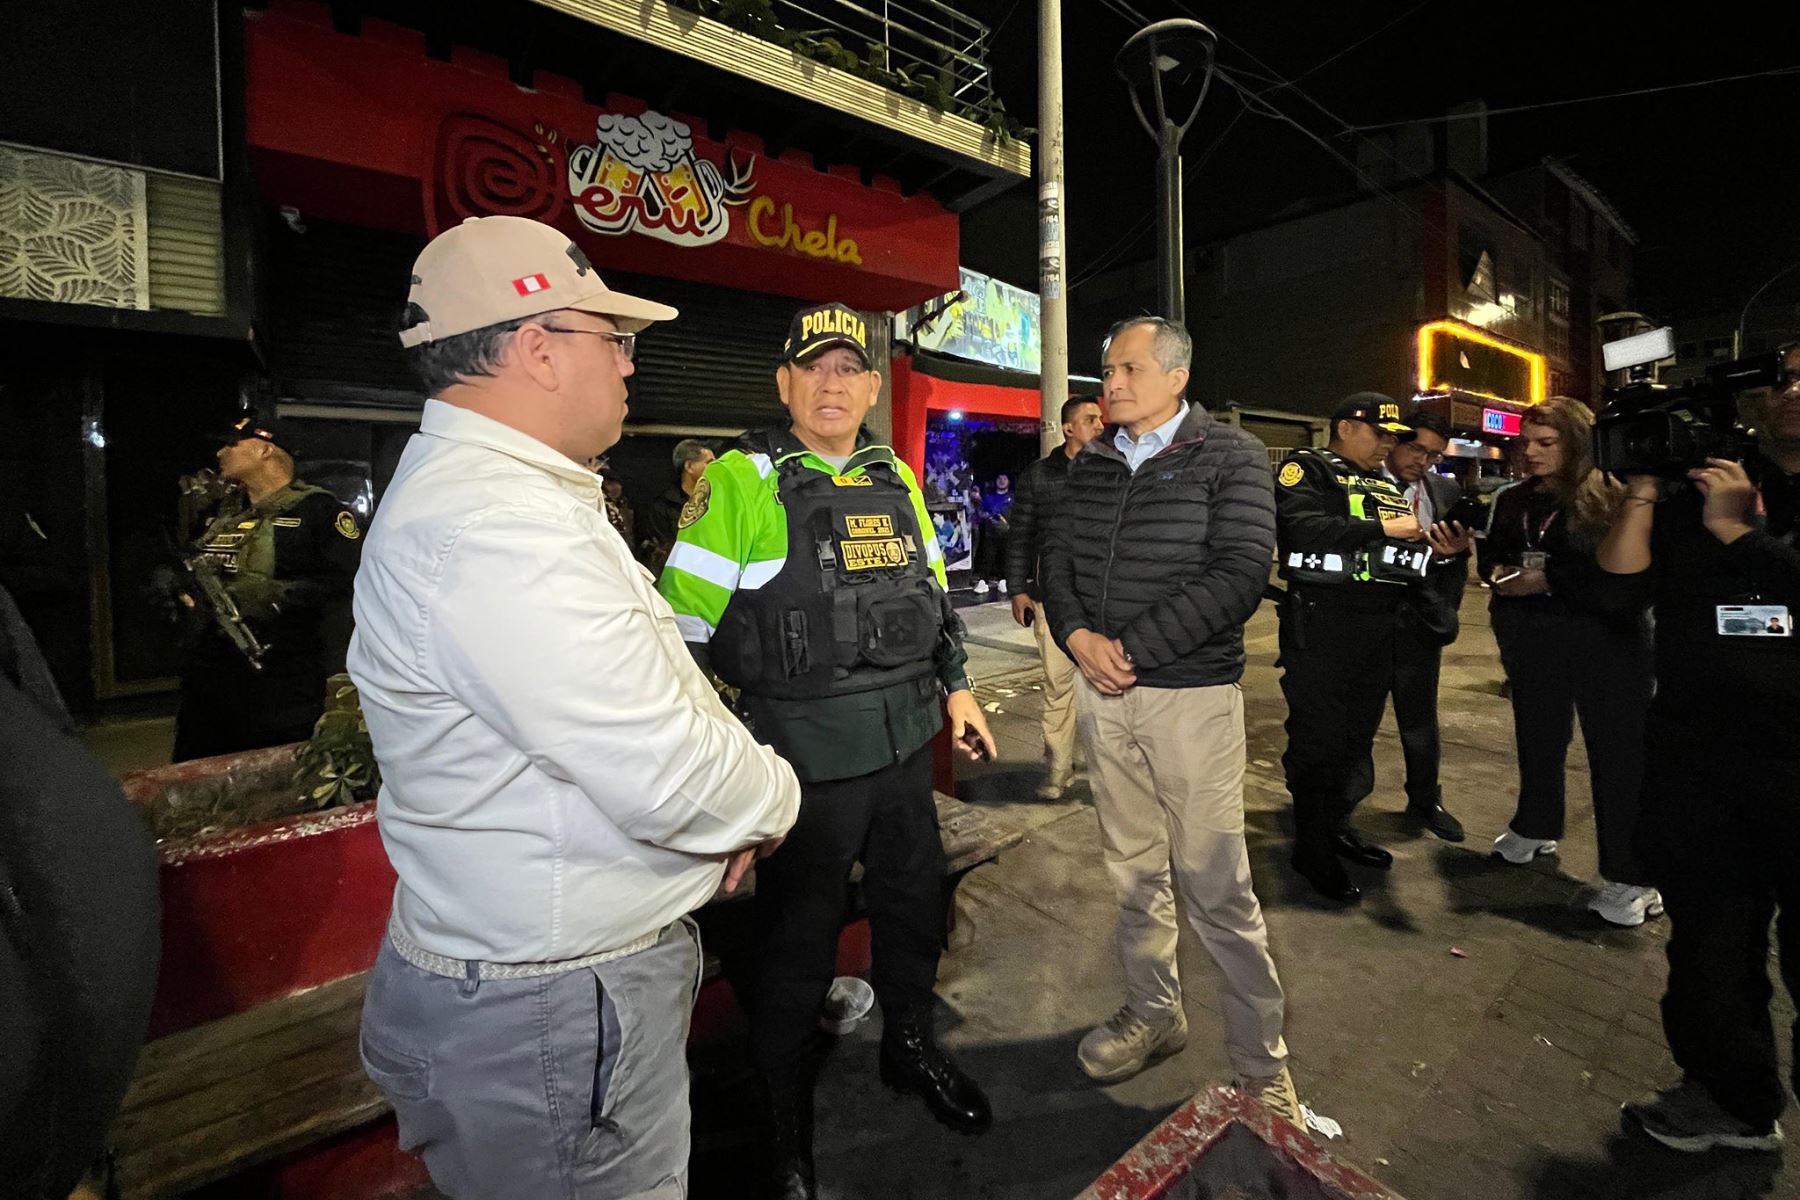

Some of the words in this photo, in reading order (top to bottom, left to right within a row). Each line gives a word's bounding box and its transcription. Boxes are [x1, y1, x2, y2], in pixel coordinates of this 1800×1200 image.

[749, 196, 862, 265] Chela
[801, 309, 867, 349] POLICIA
[845, 543, 886, 559] DIVOPUS
[848, 557, 882, 567] ESTE
